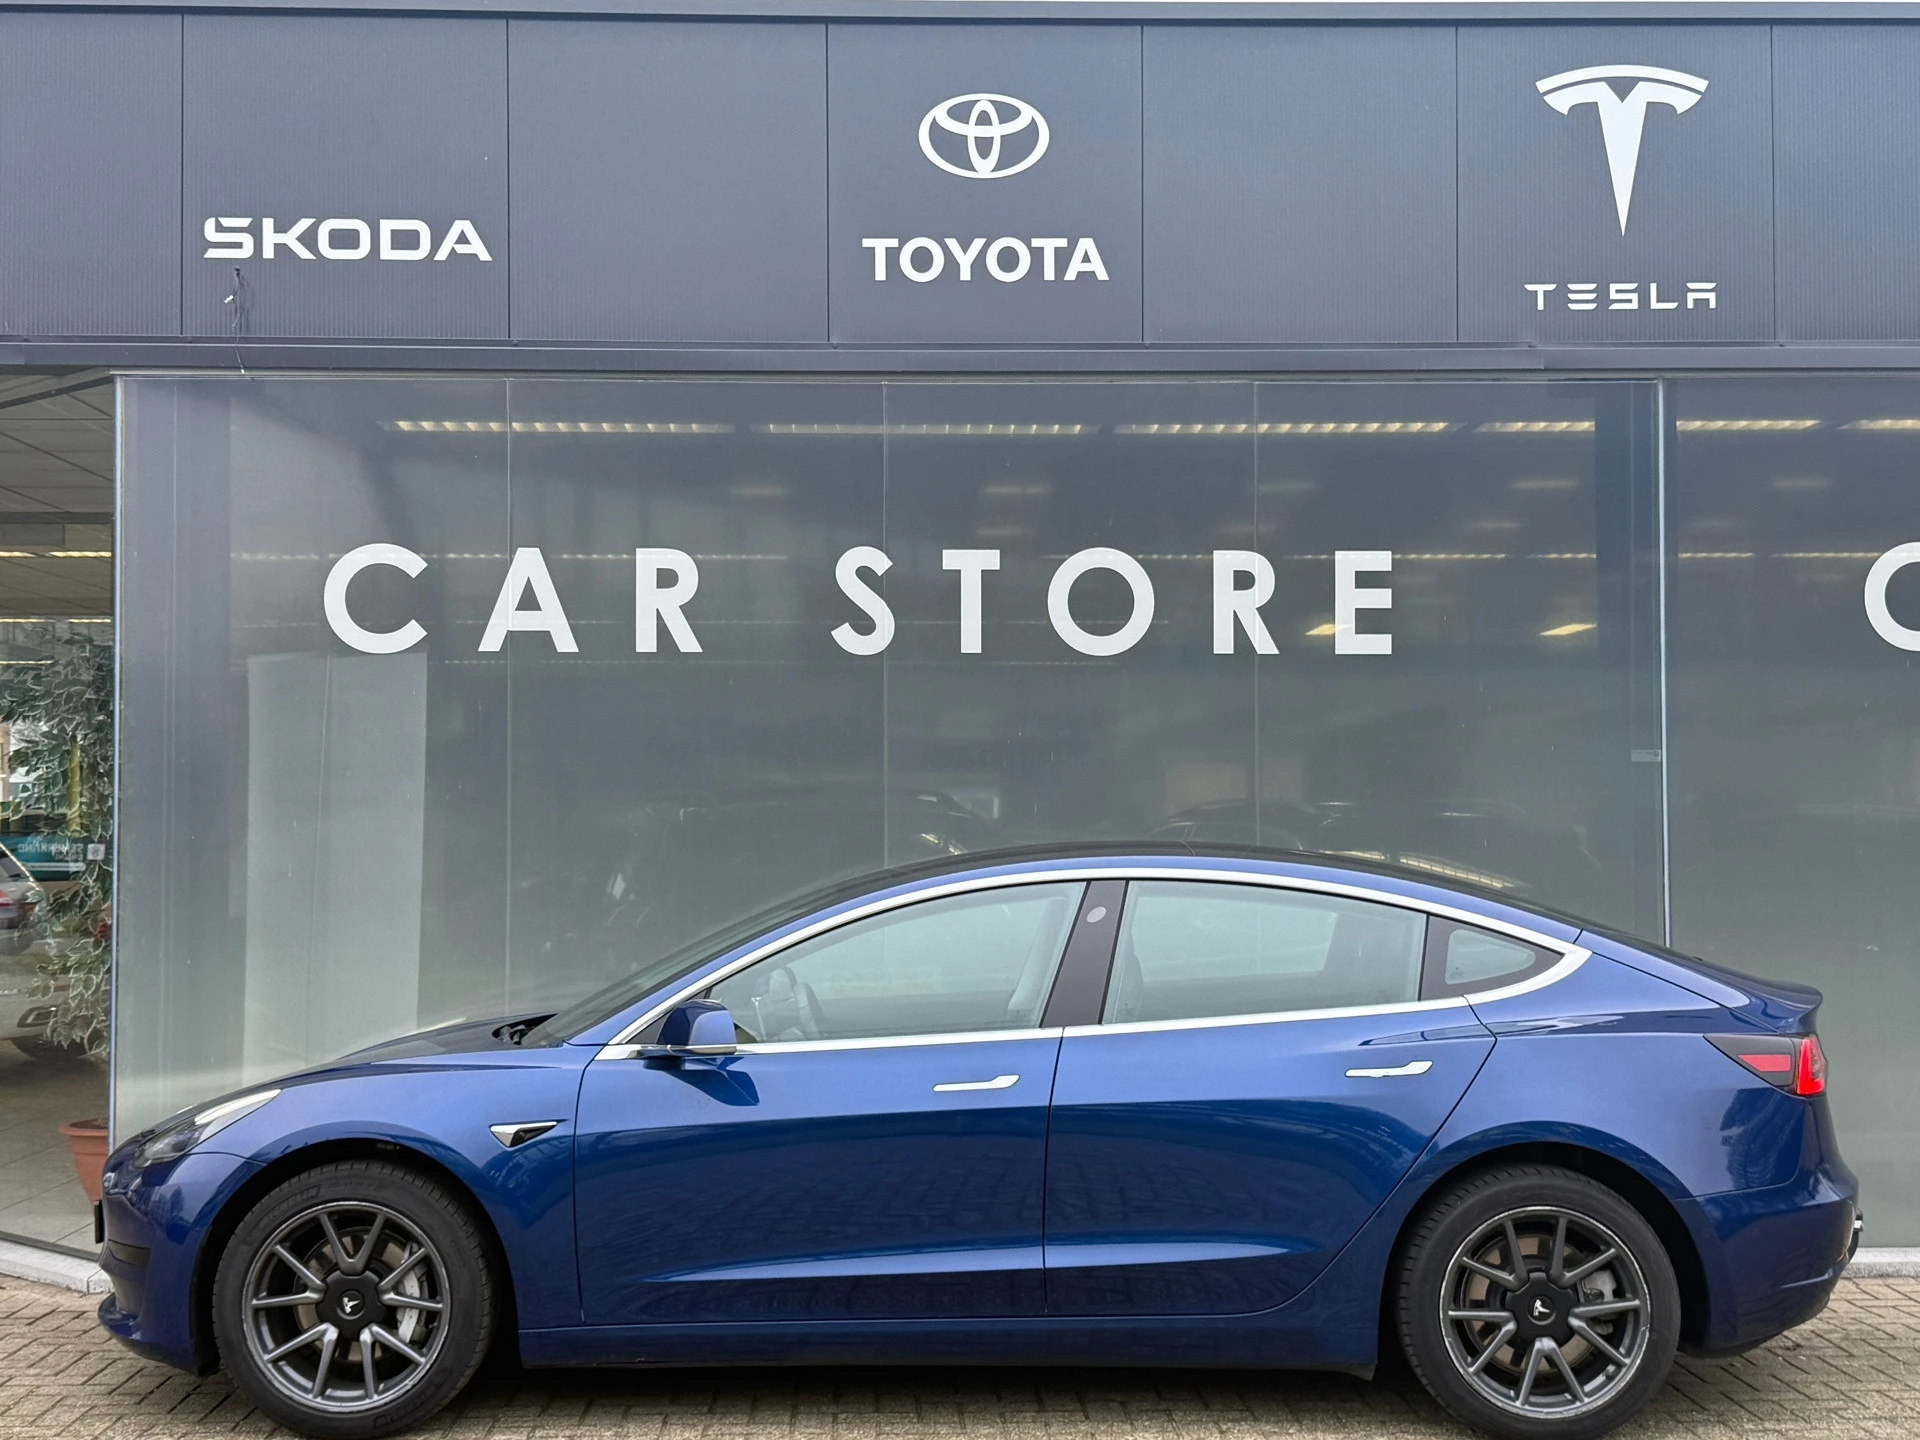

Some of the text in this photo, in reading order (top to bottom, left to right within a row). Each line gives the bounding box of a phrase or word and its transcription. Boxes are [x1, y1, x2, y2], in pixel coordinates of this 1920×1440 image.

[203, 217, 493, 262] SKODA
[861, 236, 1110, 283] TOYOTA
[1524, 282, 1718, 311] TESLA
[323, 542, 1395, 657] CAR STORE
